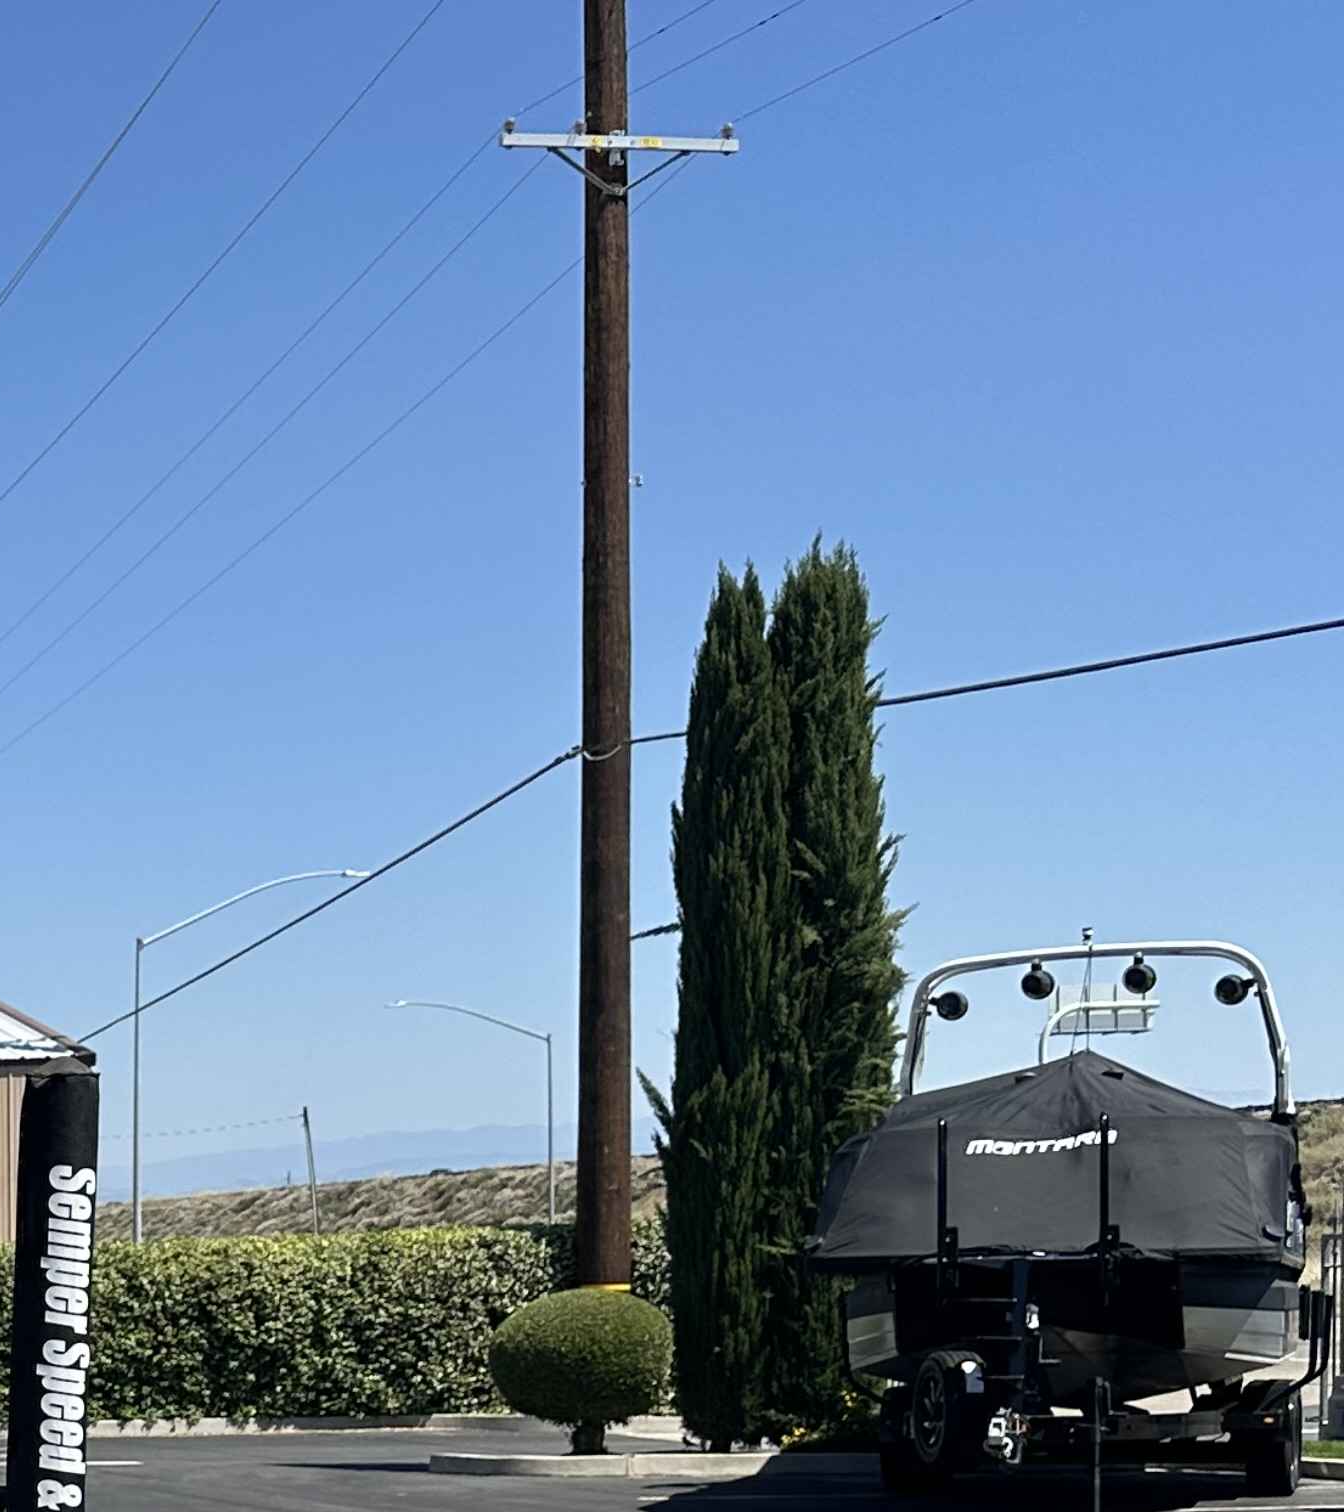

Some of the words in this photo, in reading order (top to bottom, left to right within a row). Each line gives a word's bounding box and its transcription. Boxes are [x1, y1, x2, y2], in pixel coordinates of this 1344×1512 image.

[40, 1163, 97, 1335] Semper
[36, 1339, 91, 1475] Speed
[36, 1478, 83, 1512] &
